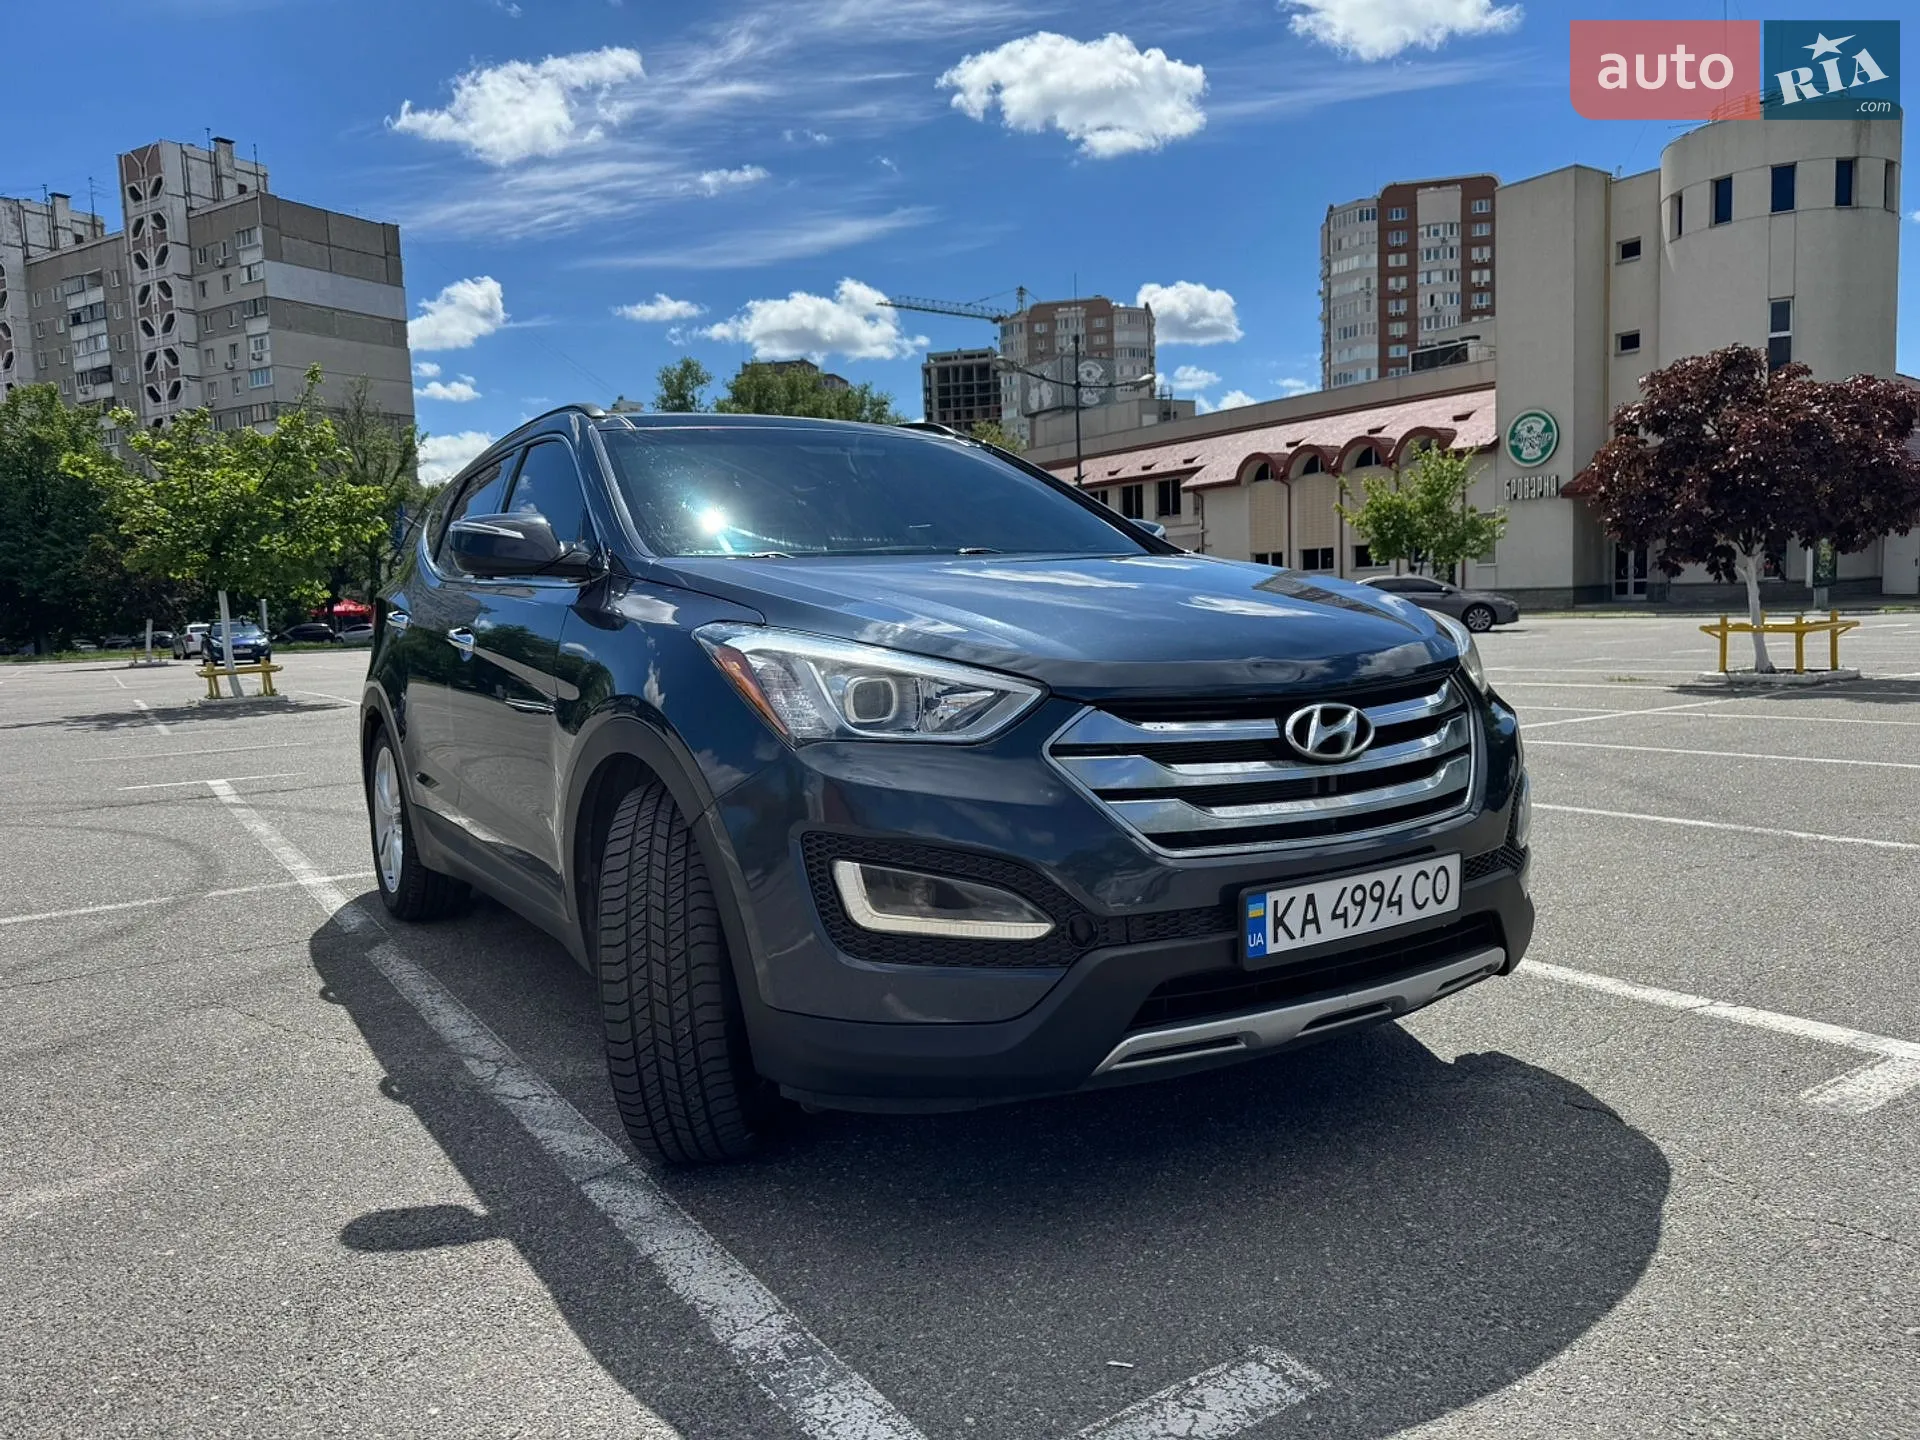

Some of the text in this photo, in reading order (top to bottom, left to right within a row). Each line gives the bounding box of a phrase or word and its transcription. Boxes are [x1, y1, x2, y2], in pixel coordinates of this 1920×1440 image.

[1273, 864, 1450, 944] KA 4994 CO
[1247, 931, 1265, 948] UA
